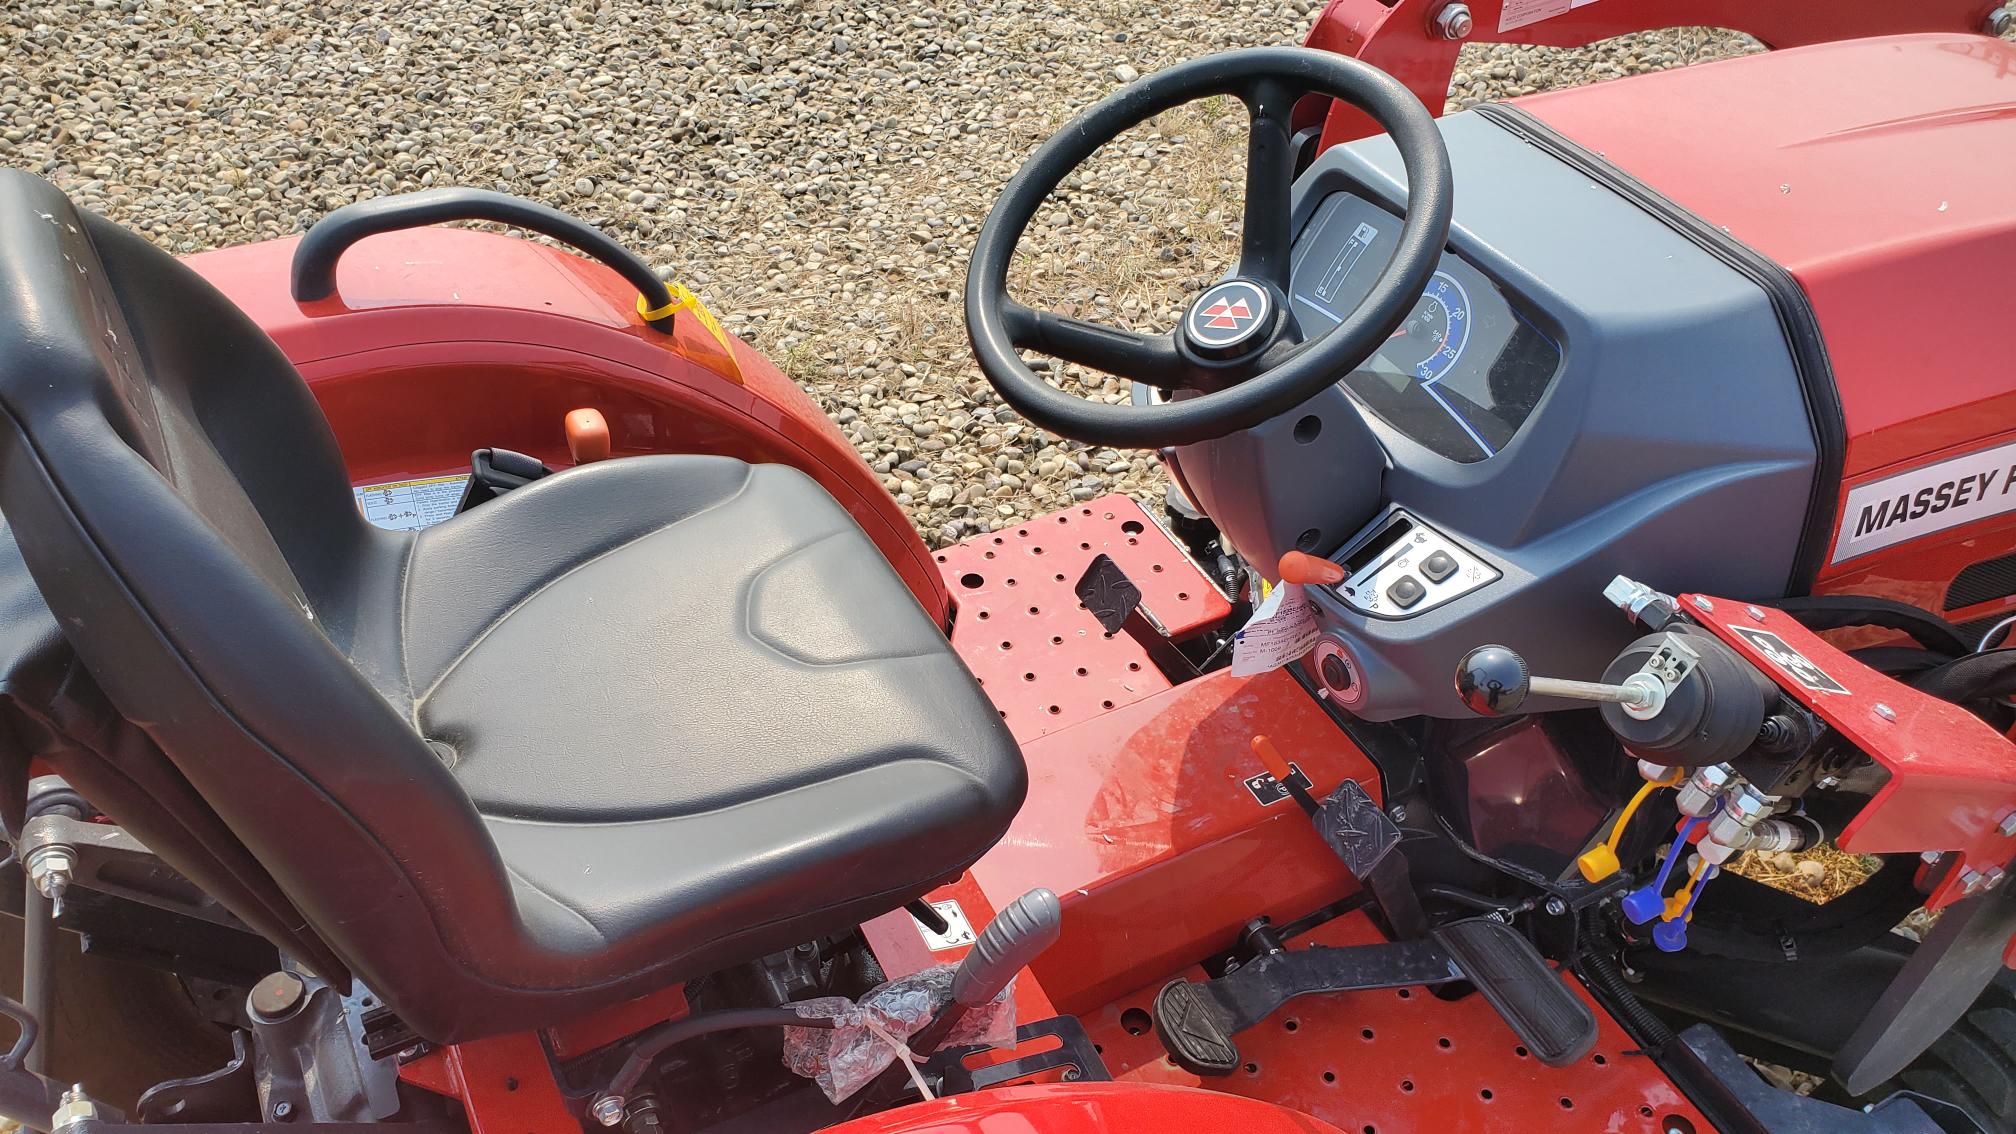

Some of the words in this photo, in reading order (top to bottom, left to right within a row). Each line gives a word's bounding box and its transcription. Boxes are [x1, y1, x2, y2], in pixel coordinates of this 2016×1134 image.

[1437, 281, 1449, 293] 15
[1452, 307, 1465, 321] 20
[1442, 346, 1456, 359] 25
[1420, 366, 1433, 380] 30
[1854, 469, 1999, 538] MASSEY
